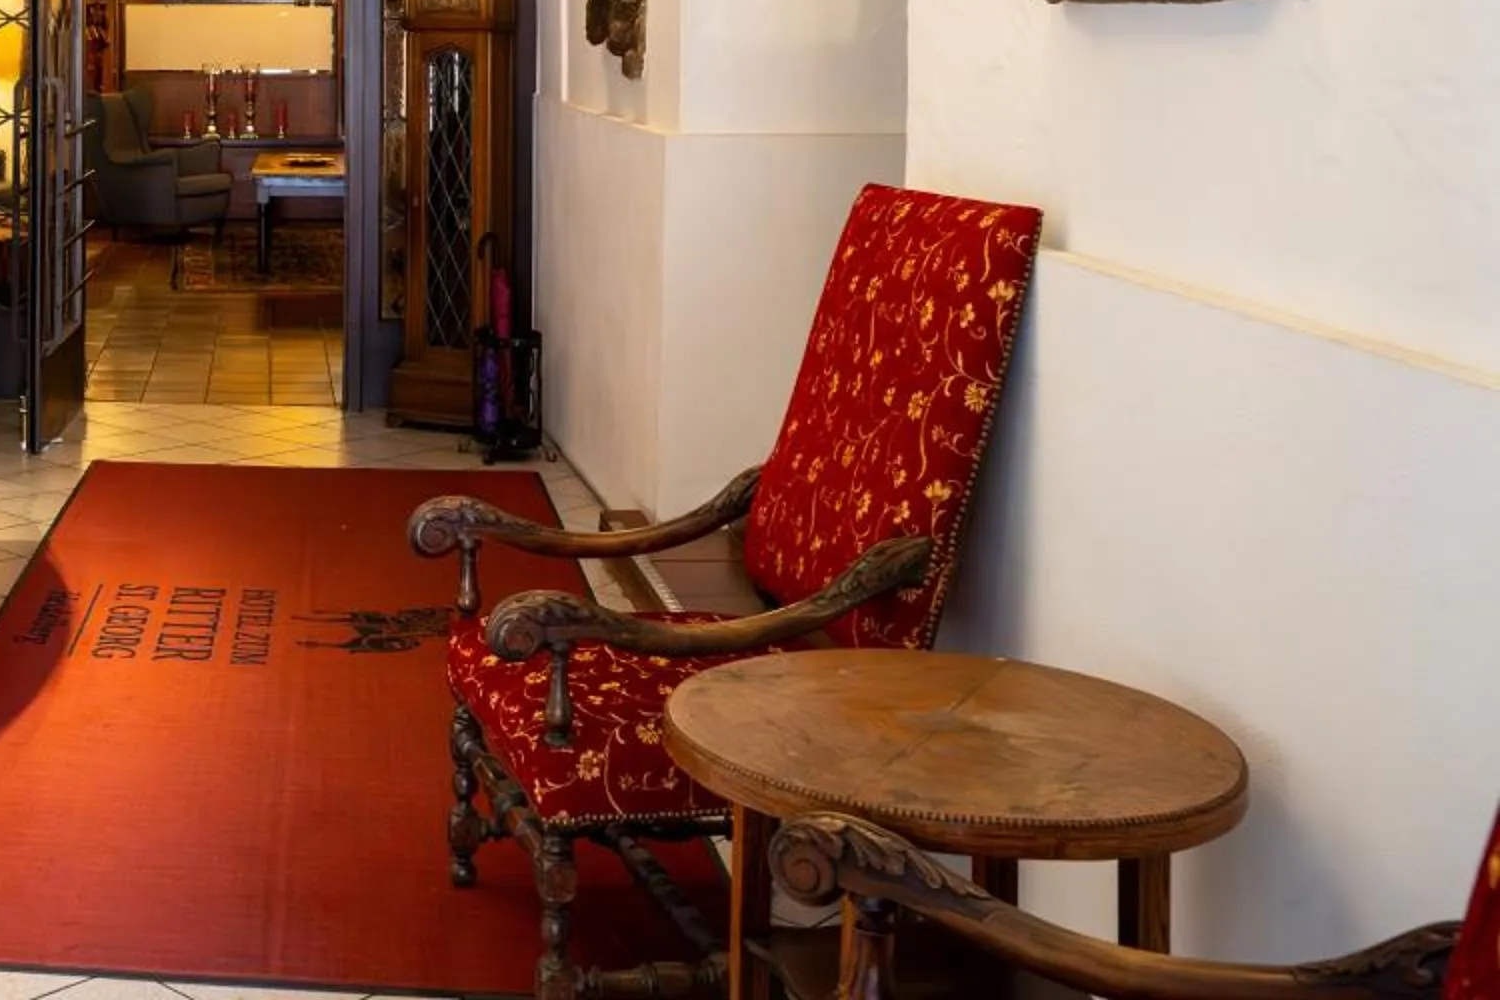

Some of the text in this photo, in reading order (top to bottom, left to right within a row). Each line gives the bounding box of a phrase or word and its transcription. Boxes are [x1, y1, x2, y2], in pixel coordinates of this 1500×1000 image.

[91, 584, 159, 659] ST. GEORG
[151, 587, 226, 661] RITTER
[230, 588, 276, 665] HOTEL ZUM
